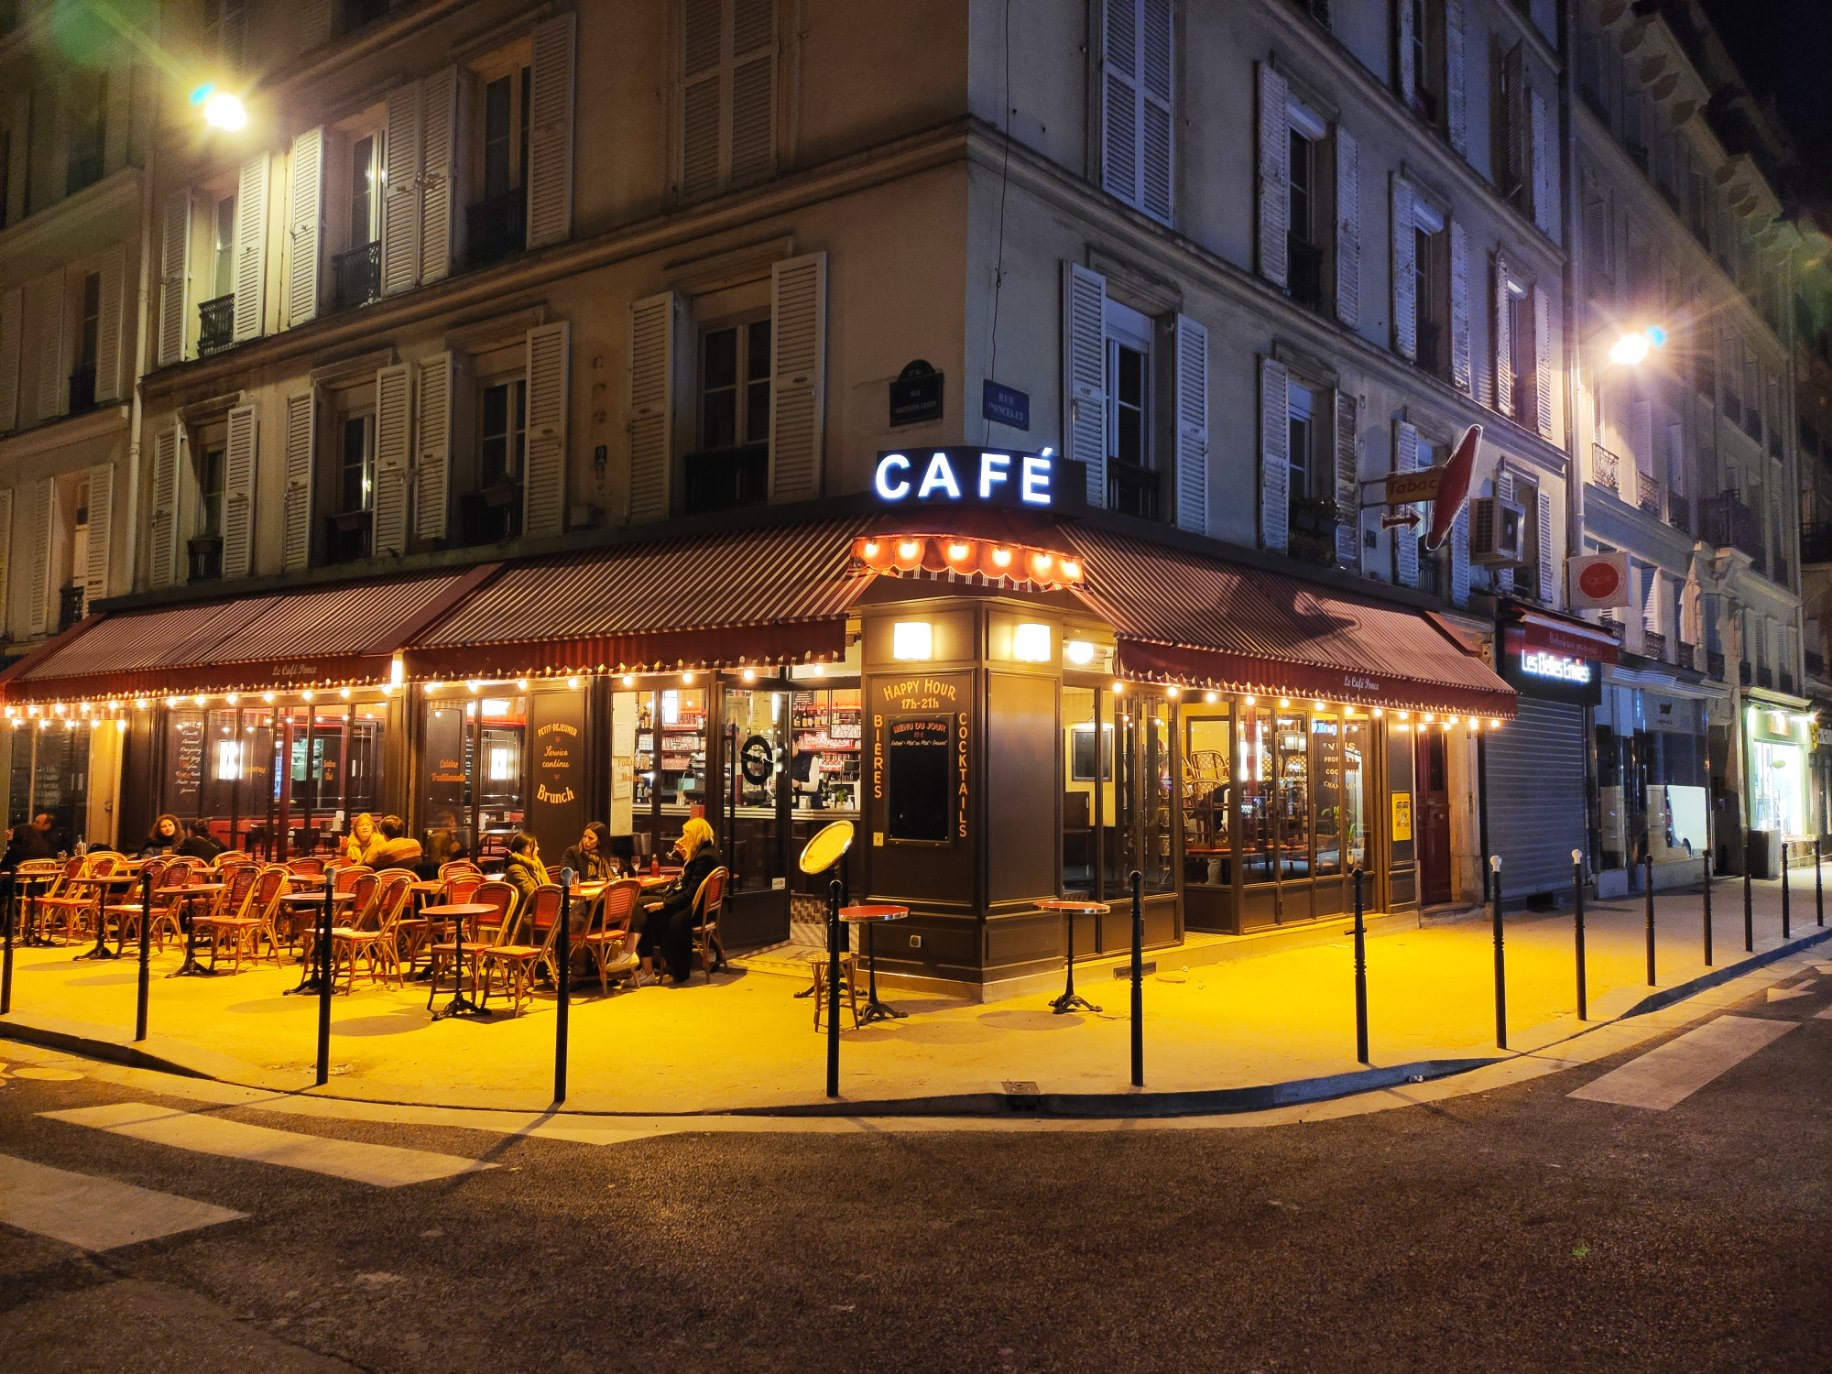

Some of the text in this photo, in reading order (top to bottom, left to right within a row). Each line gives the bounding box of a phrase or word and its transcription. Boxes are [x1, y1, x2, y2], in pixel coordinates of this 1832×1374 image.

[998, 392, 1015, 405] RUE
[988, 401, 1025, 422] PONCELET
[875, 447, 1053, 505] CAFÉ
[1387, 479, 1438, 496] Tabac
[1521, 649, 1538, 673] Les
[272, 665, 280, 676] Le
[282, 664, 297, 678] Café
[883, 678, 956, 701] HAPPY HOUR
[1344, 675, 1351, 687] Le
[1351, 676, 1365, 691] Café
[893, 722, 946, 734] MENU DU JOUR
[543, 745, 569, 757] Service
[541, 759, 570, 768] continu
[958, 712, 969, 837] COCKTAILS
[537, 783, 575, 804] Brunch
